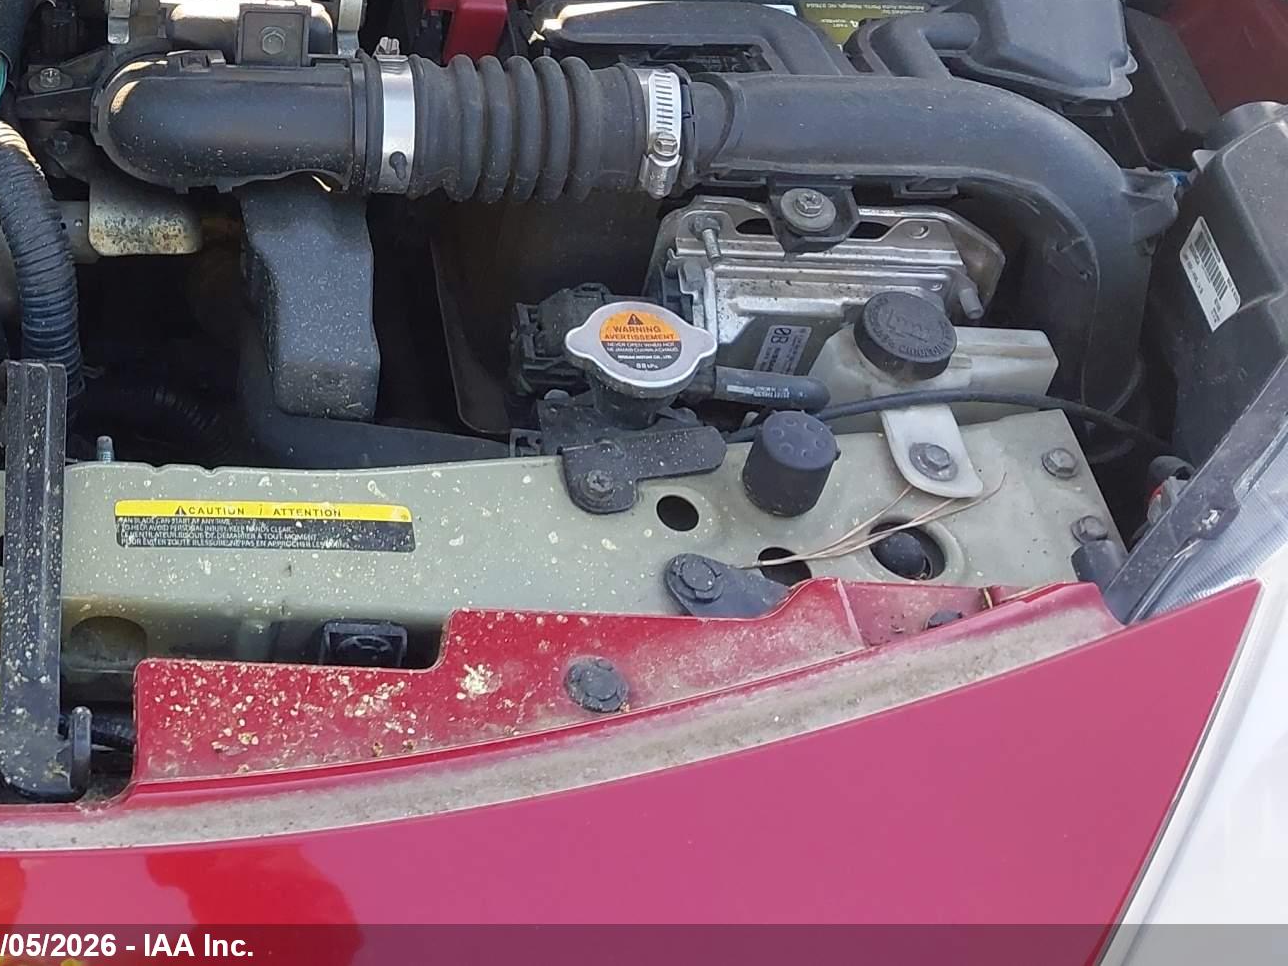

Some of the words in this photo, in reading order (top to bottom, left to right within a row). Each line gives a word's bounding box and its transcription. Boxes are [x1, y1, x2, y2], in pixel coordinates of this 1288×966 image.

[613, 325, 661, 333] WARNING
[188, 506, 245, 515] CAUTION
[273, 507, 341, 517] ATTENTION
[167, 538, 190, 546] TOUTE
[241, 539, 254, 547] PAS
[255, 539, 266, 547] EN
